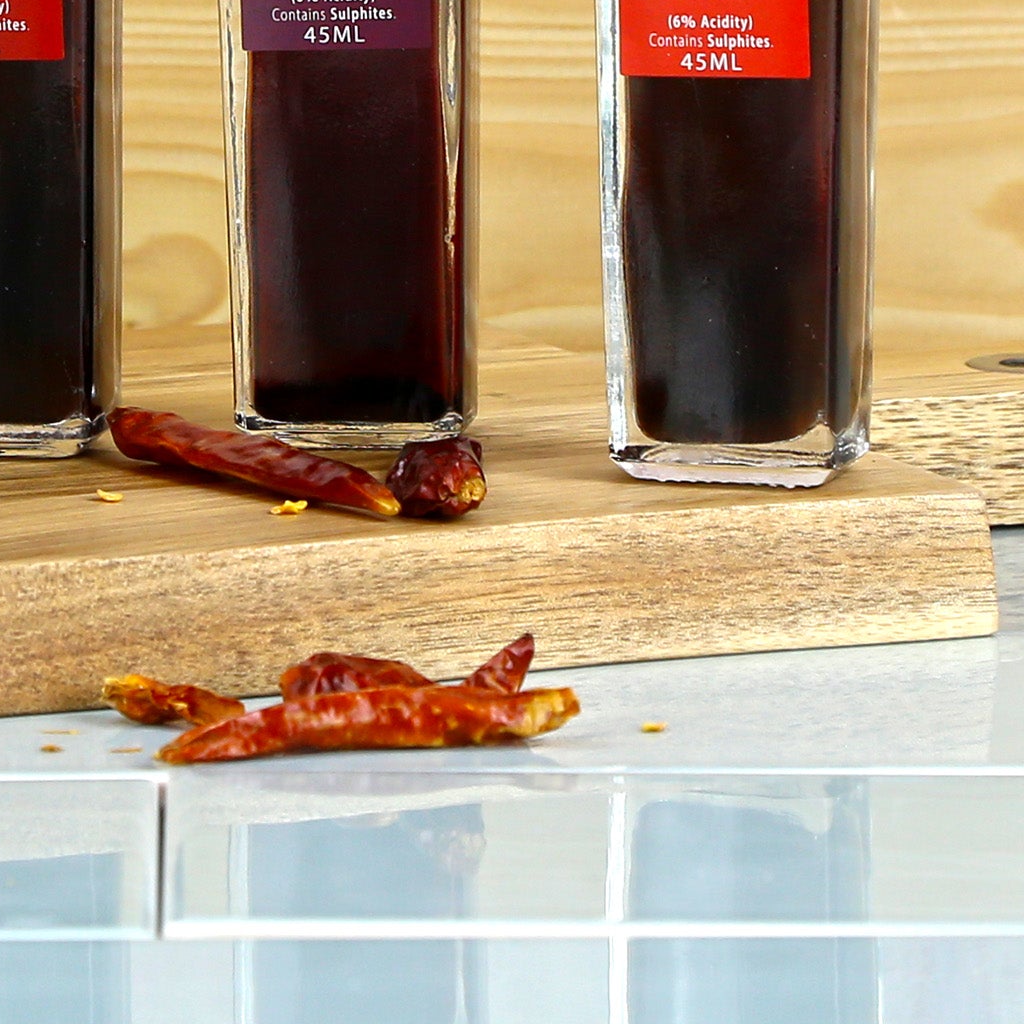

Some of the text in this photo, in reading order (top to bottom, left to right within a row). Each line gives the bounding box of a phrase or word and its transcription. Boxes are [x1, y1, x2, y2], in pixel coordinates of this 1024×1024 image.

[272, 7, 396, 23] Contains Sulphites.
[668, 15, 753, 31] (6% Acidity)
[304, 26, 365, 44] 45ML
[649, 33, 774, 50] Contains Sulphites.
[680, 53, 742, 71] 45ML
